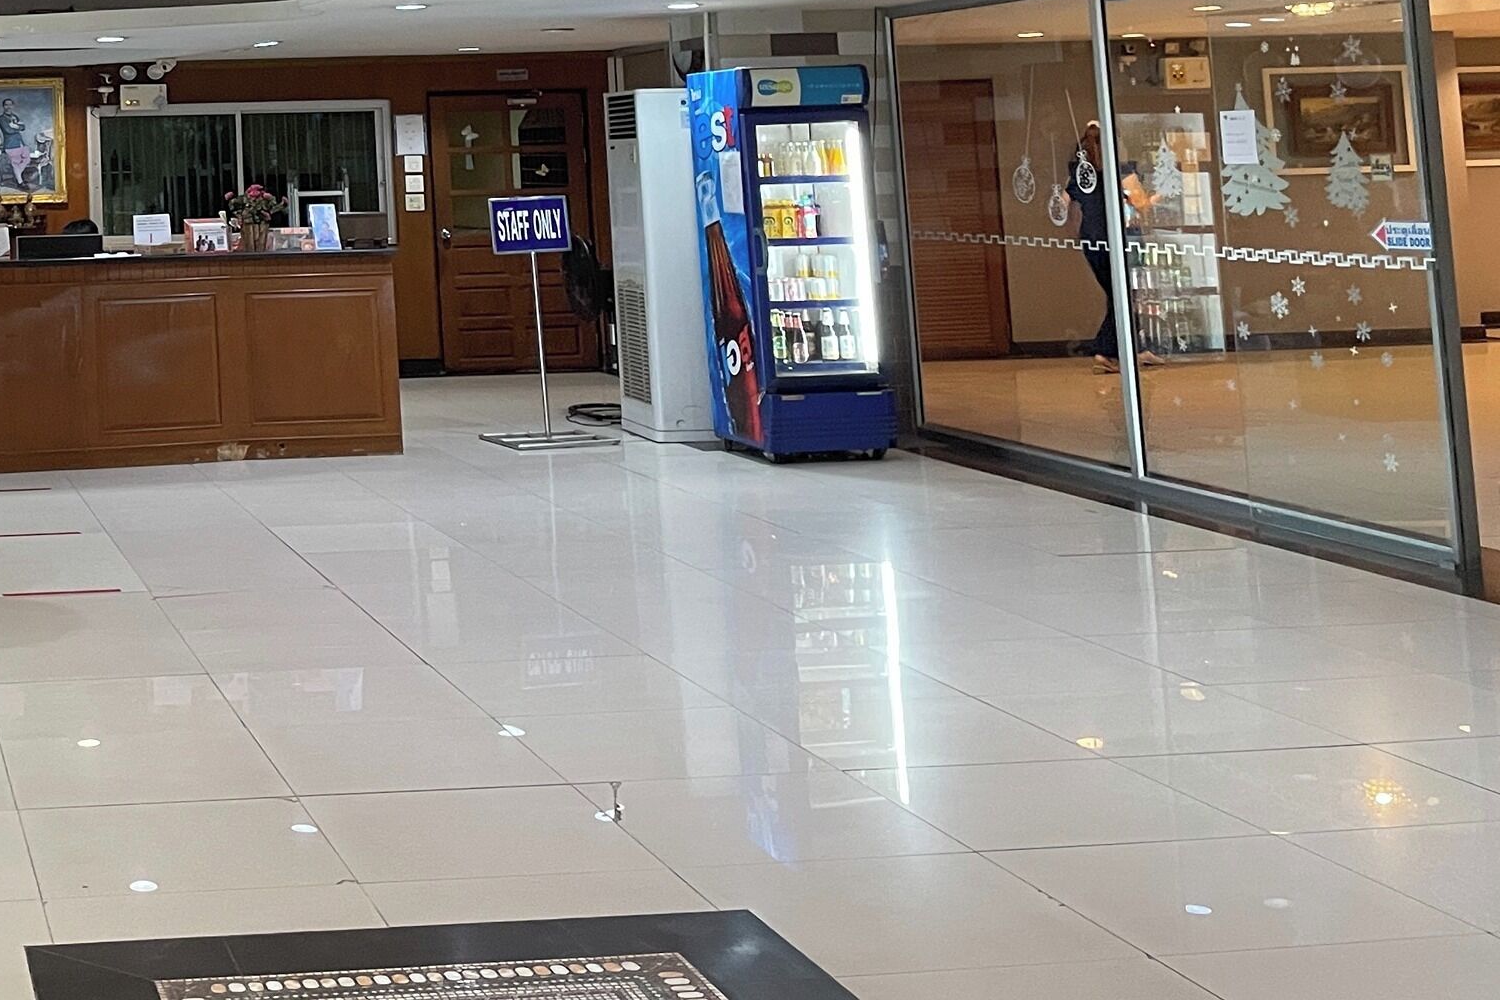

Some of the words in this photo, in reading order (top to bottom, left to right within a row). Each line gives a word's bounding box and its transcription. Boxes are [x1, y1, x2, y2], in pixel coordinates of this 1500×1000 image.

[497, 210, 530, 242] STAFF
[533, 208, 562, 240] ONLY
[1387, 237, 1407, 247] SLIDE
[1410, 237, 1431, 247] DOOR
